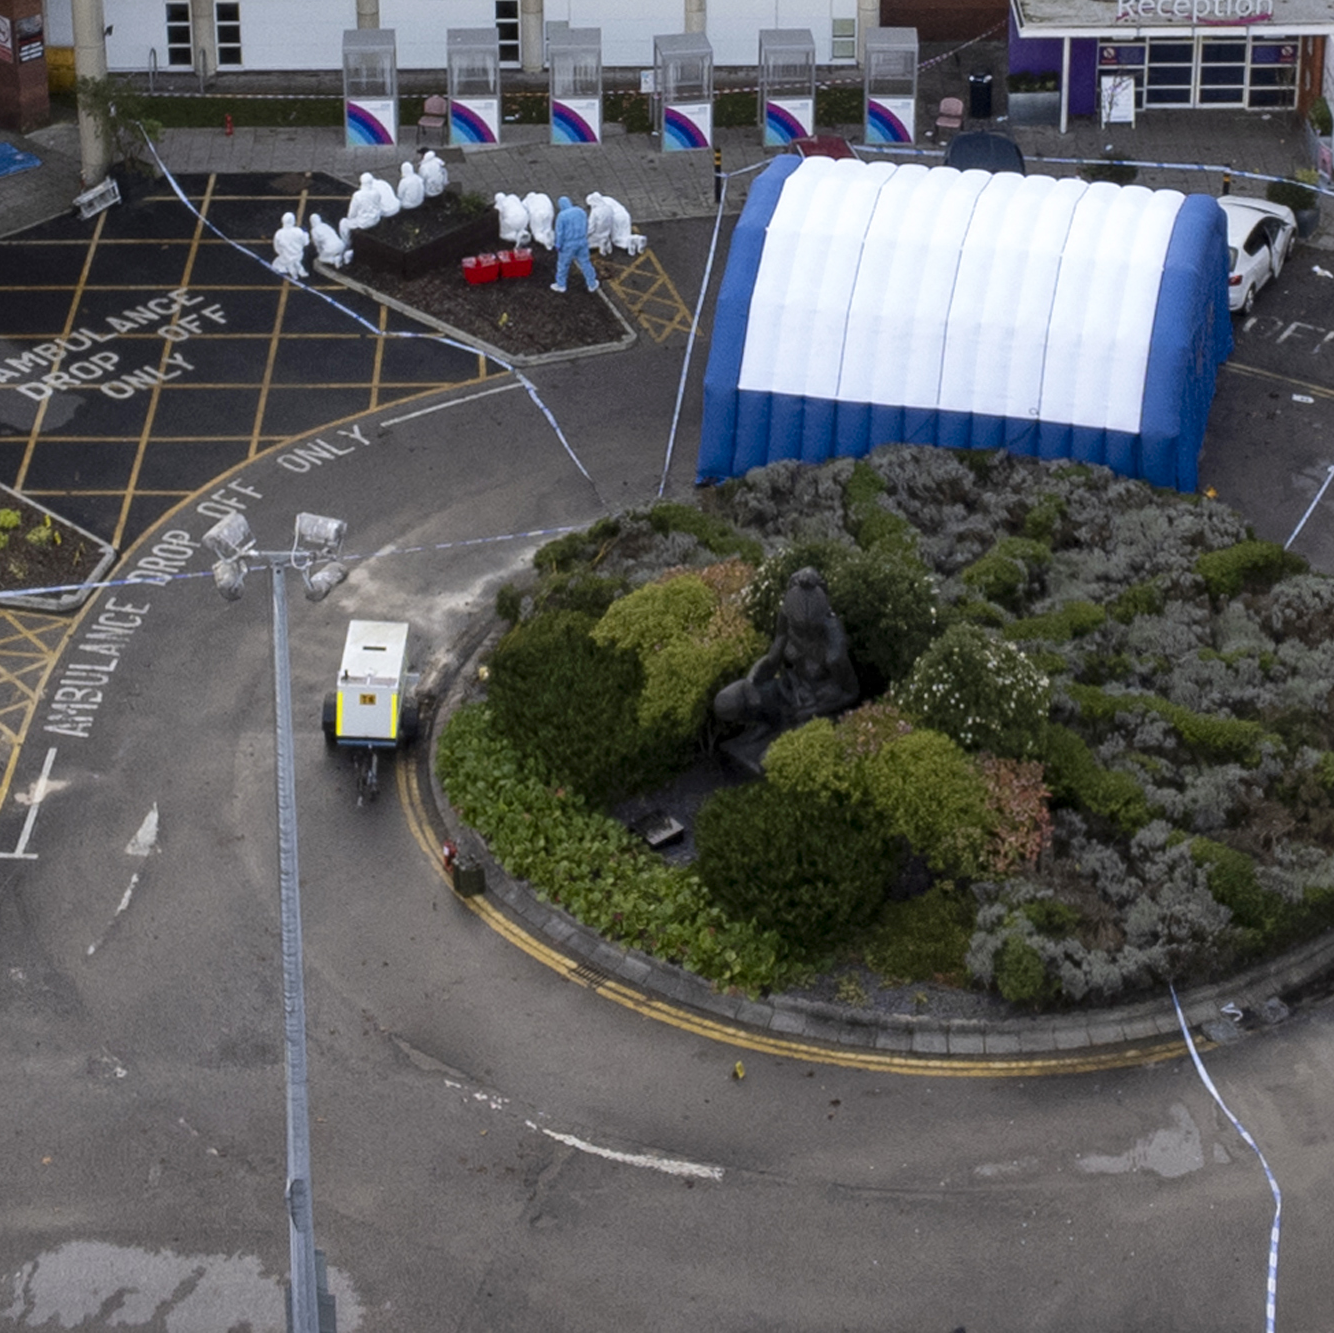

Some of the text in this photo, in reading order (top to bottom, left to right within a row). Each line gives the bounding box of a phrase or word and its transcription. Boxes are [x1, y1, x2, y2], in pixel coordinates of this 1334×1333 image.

[16, 304, 228, 401] DROP OFF
[100, 352, 195, 399] ONLY
[43, 425, 370, 738] AMBULANCE DROP OFF ONLY
